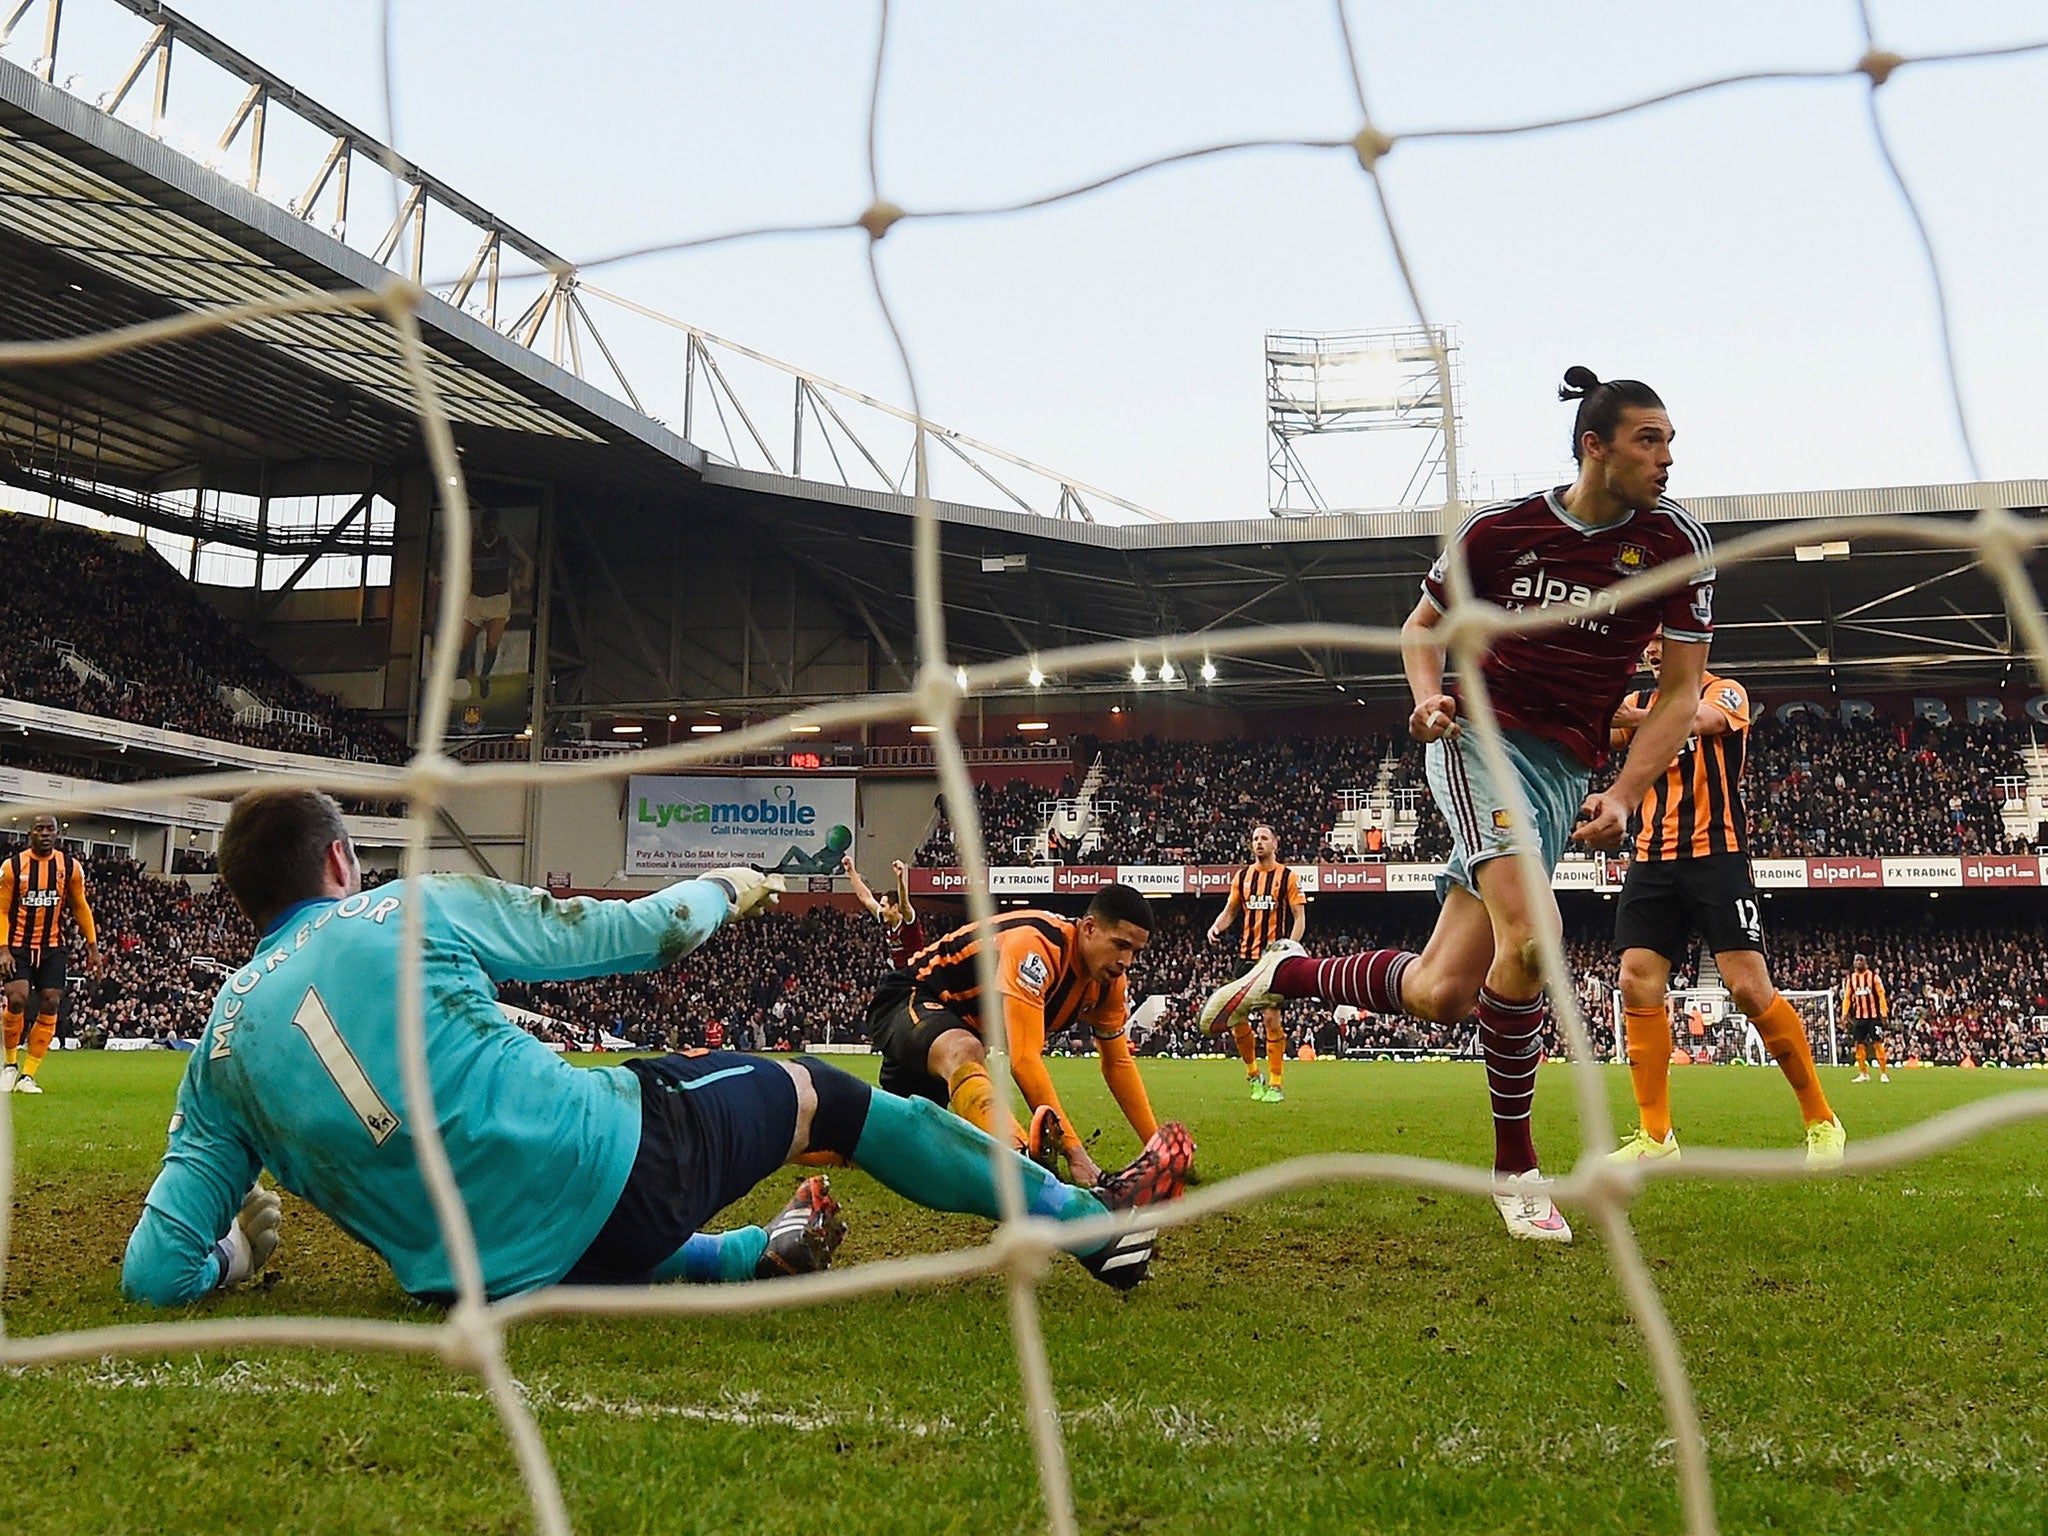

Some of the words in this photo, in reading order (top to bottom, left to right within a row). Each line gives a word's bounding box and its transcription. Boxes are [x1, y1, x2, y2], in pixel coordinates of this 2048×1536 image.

[1506, 600, 1524, 613] FX
[638, 797, 816, 828] Lycamobile
[711, 825, 731, 835] Call
[732, 825, 749, 835] the
[749, 826, 778, 836] world
[780, 827, 794, 836] for
[795, 827, 816, 837] less
[636, 850, 651, 860] Pay
[653, 850, 665, 858] As
[667, 850, 682, 858] You
[746, 851, 765, 859] cost
[636, 860, 669, 869] national
[679, 860, 731, 869] international
[1555, 871, 1596, 881] RADING
[1753, 869, 1802, 879] TRADING
[1888, 868, 1903, 877] FX
[1906, 867, 1957, 877] TRADING
[993, 875, 1006, 884] FX
[1009, 875, 1050, 884] TRADING
[1121, 875, 1135, 884] FX
[1137, 874, 1180, 884] TRADING
[1391, 873, 1405, 882] FX
[1407, 873, 1435, 882] TRAD
[1735, 898, 1761, 932] 12
[291, 983, 400, 1148] 1
